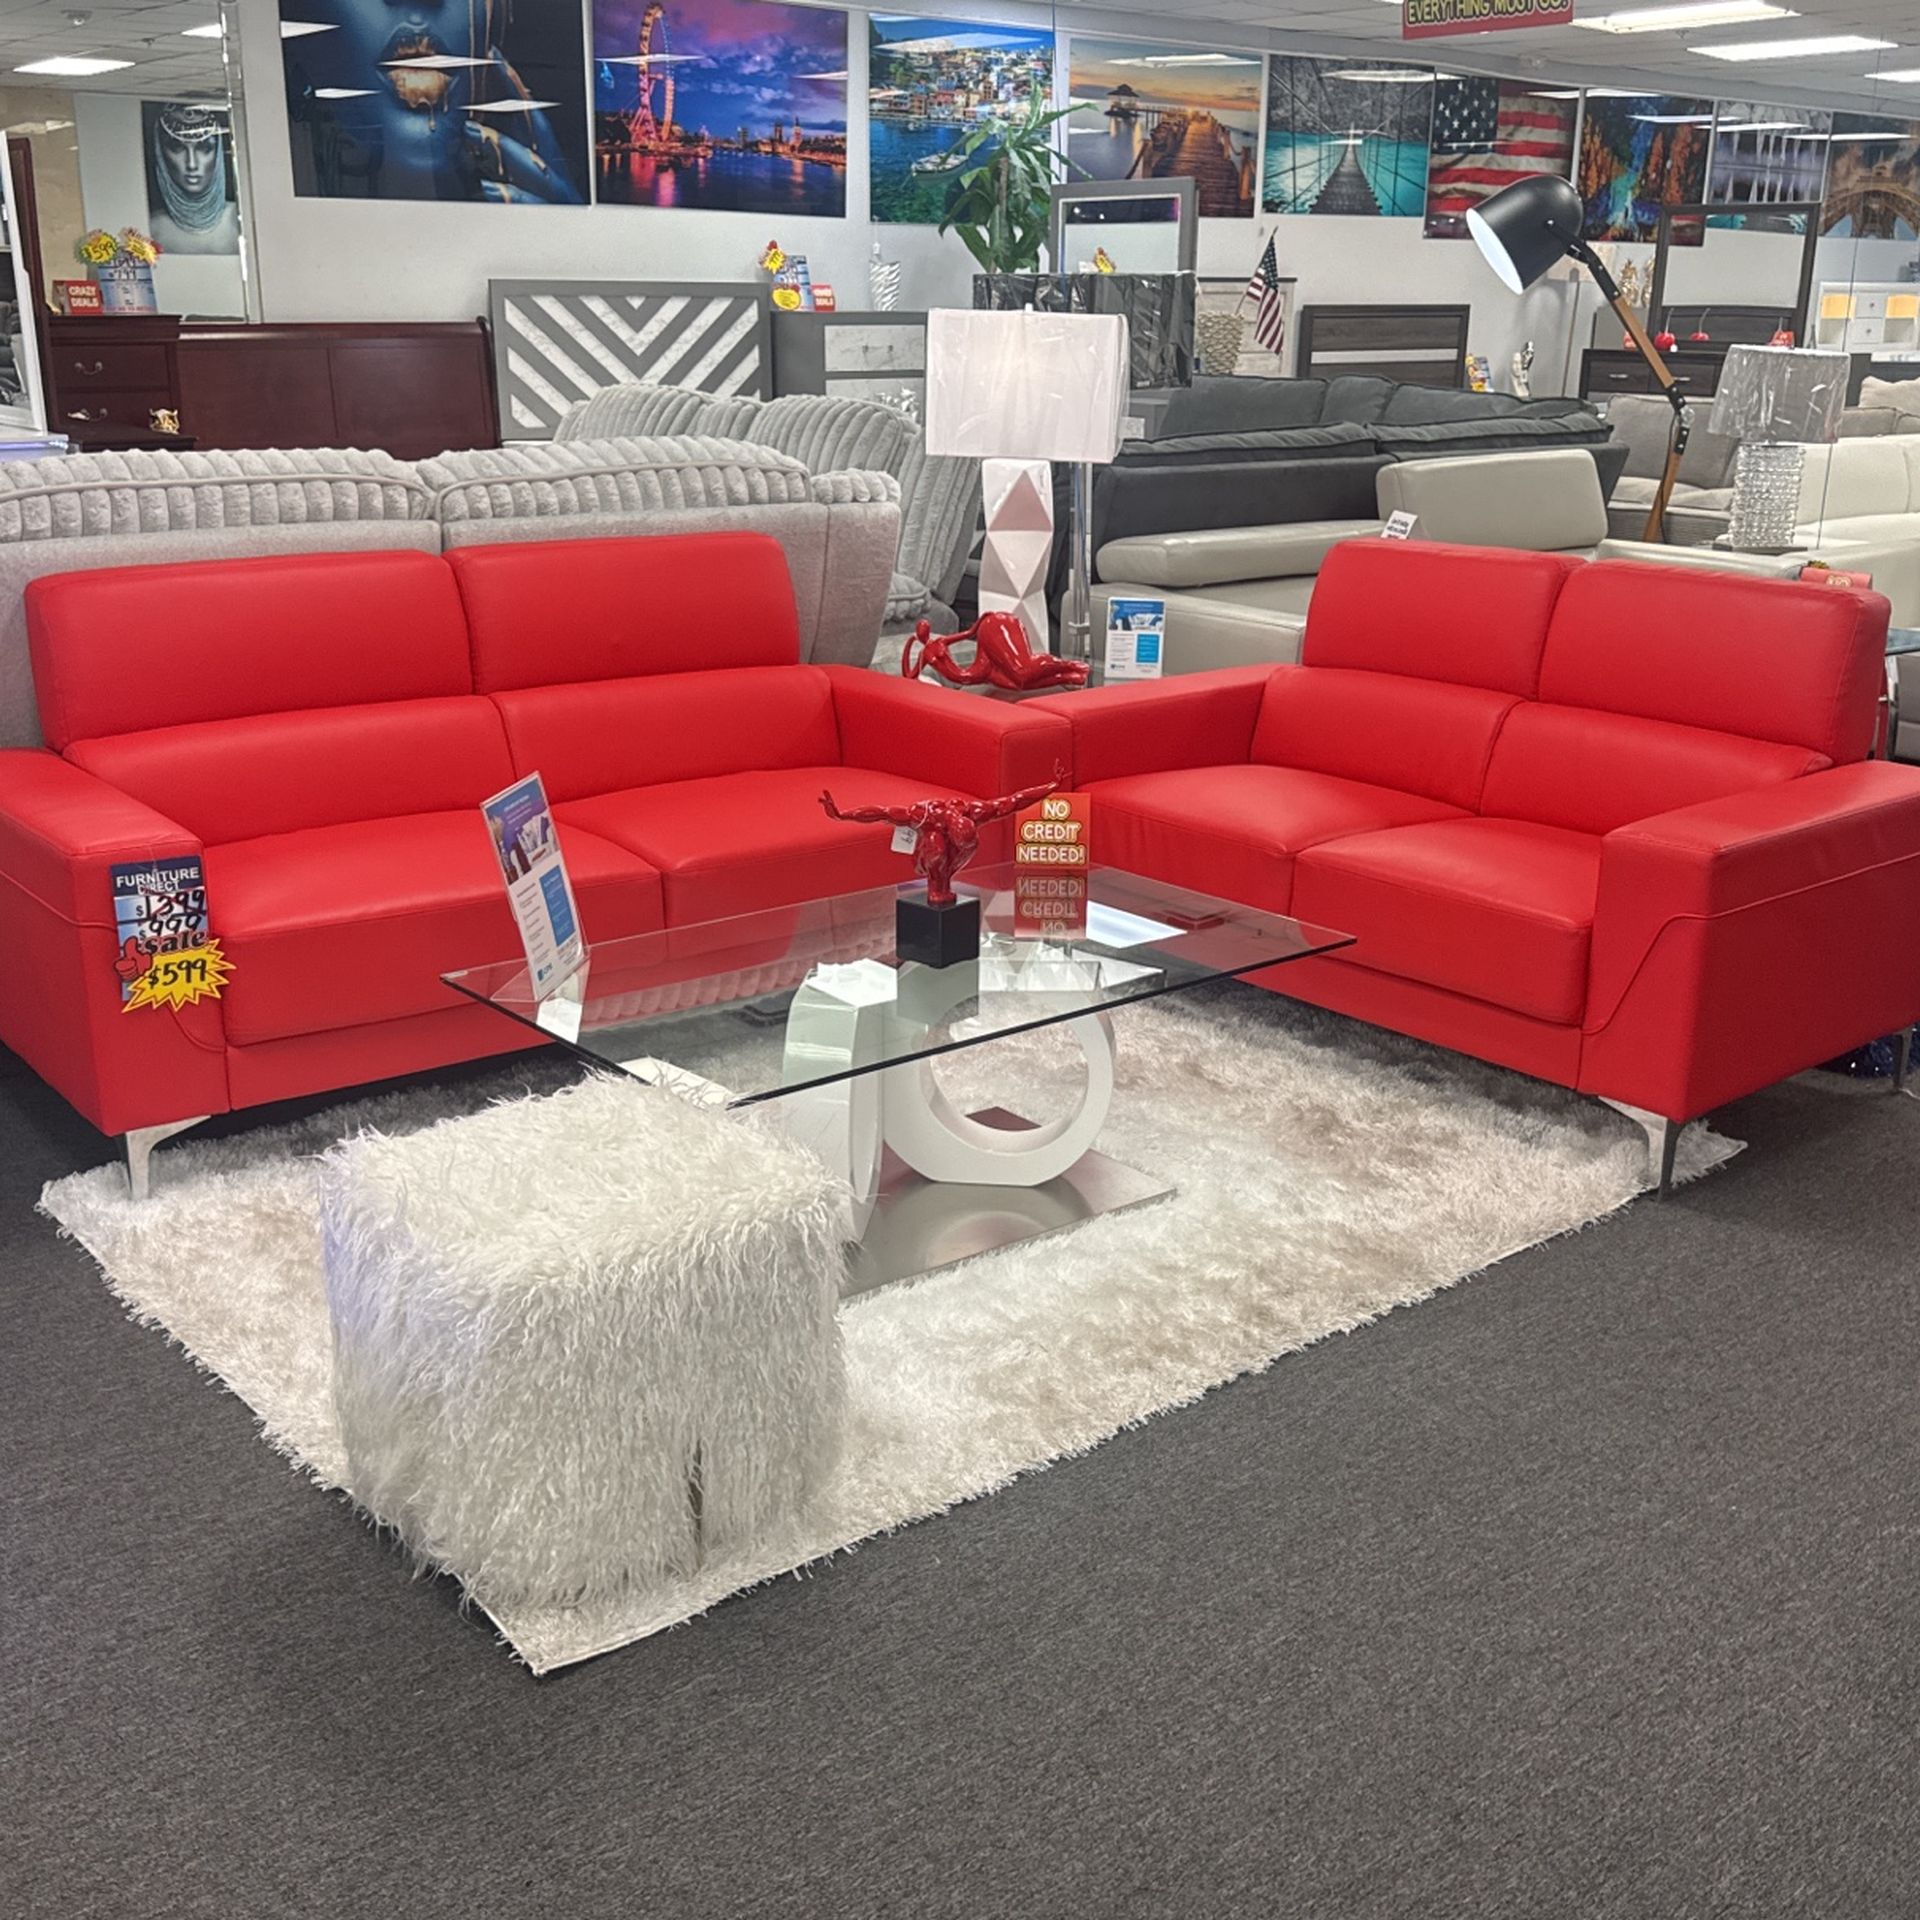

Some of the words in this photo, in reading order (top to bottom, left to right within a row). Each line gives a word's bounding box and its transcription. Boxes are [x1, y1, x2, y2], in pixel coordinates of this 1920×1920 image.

[1408, 0, 1490, 21] EVERYTHING
[69, 286, 96, 296] CRAZY
[71, 297, 99, 307] DEALS
[1043, 801, 1069, 819] NO
[1022, 823, 1080, 840] CREDIT
[1017, 846, 1084, 862] NEEDED!
[116, 867, 200, 888] FURNITURE
[137, 880, 180, 896] DIRECT
[148, 958, 207, 989] $599
